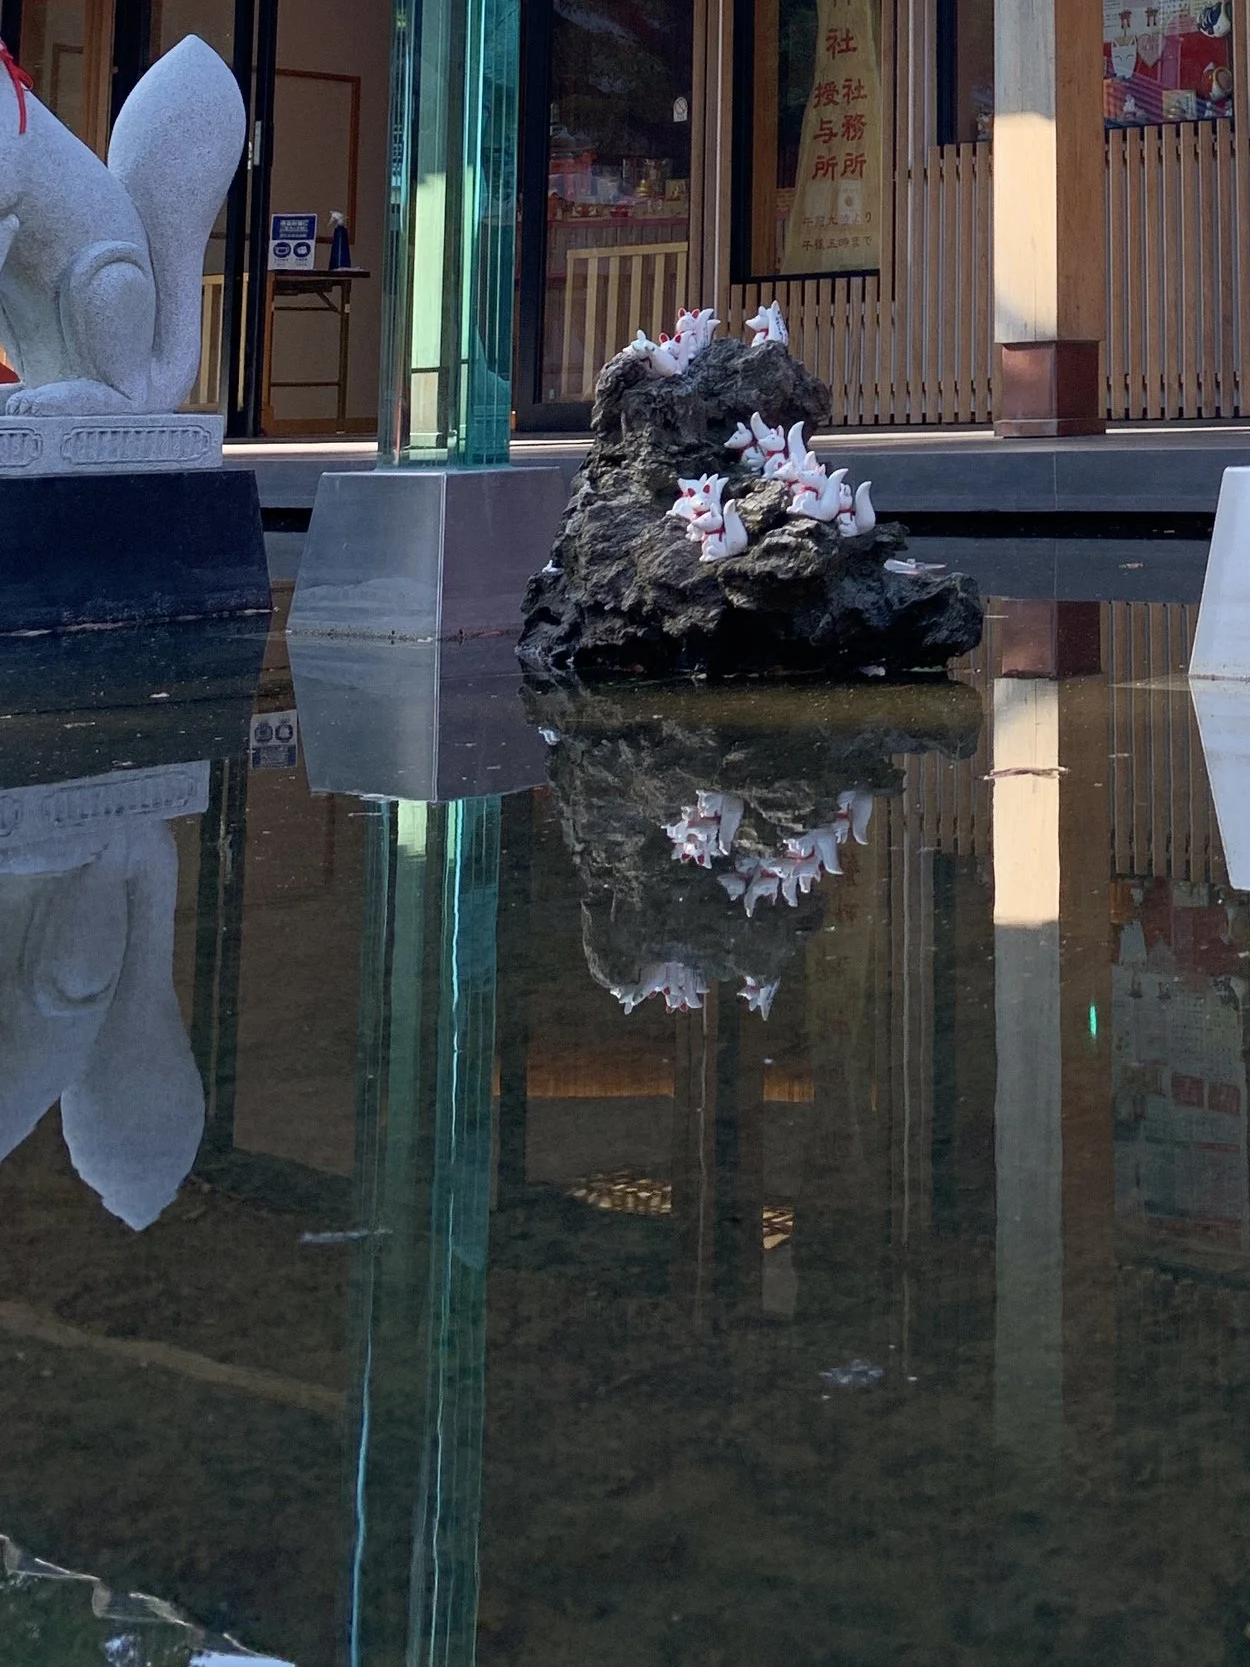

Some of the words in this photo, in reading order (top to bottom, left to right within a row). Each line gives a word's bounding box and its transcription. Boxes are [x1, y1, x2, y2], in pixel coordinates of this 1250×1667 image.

[812, 80, 840, 182] 授与所
[840, 78, 868, 179] 社務所
